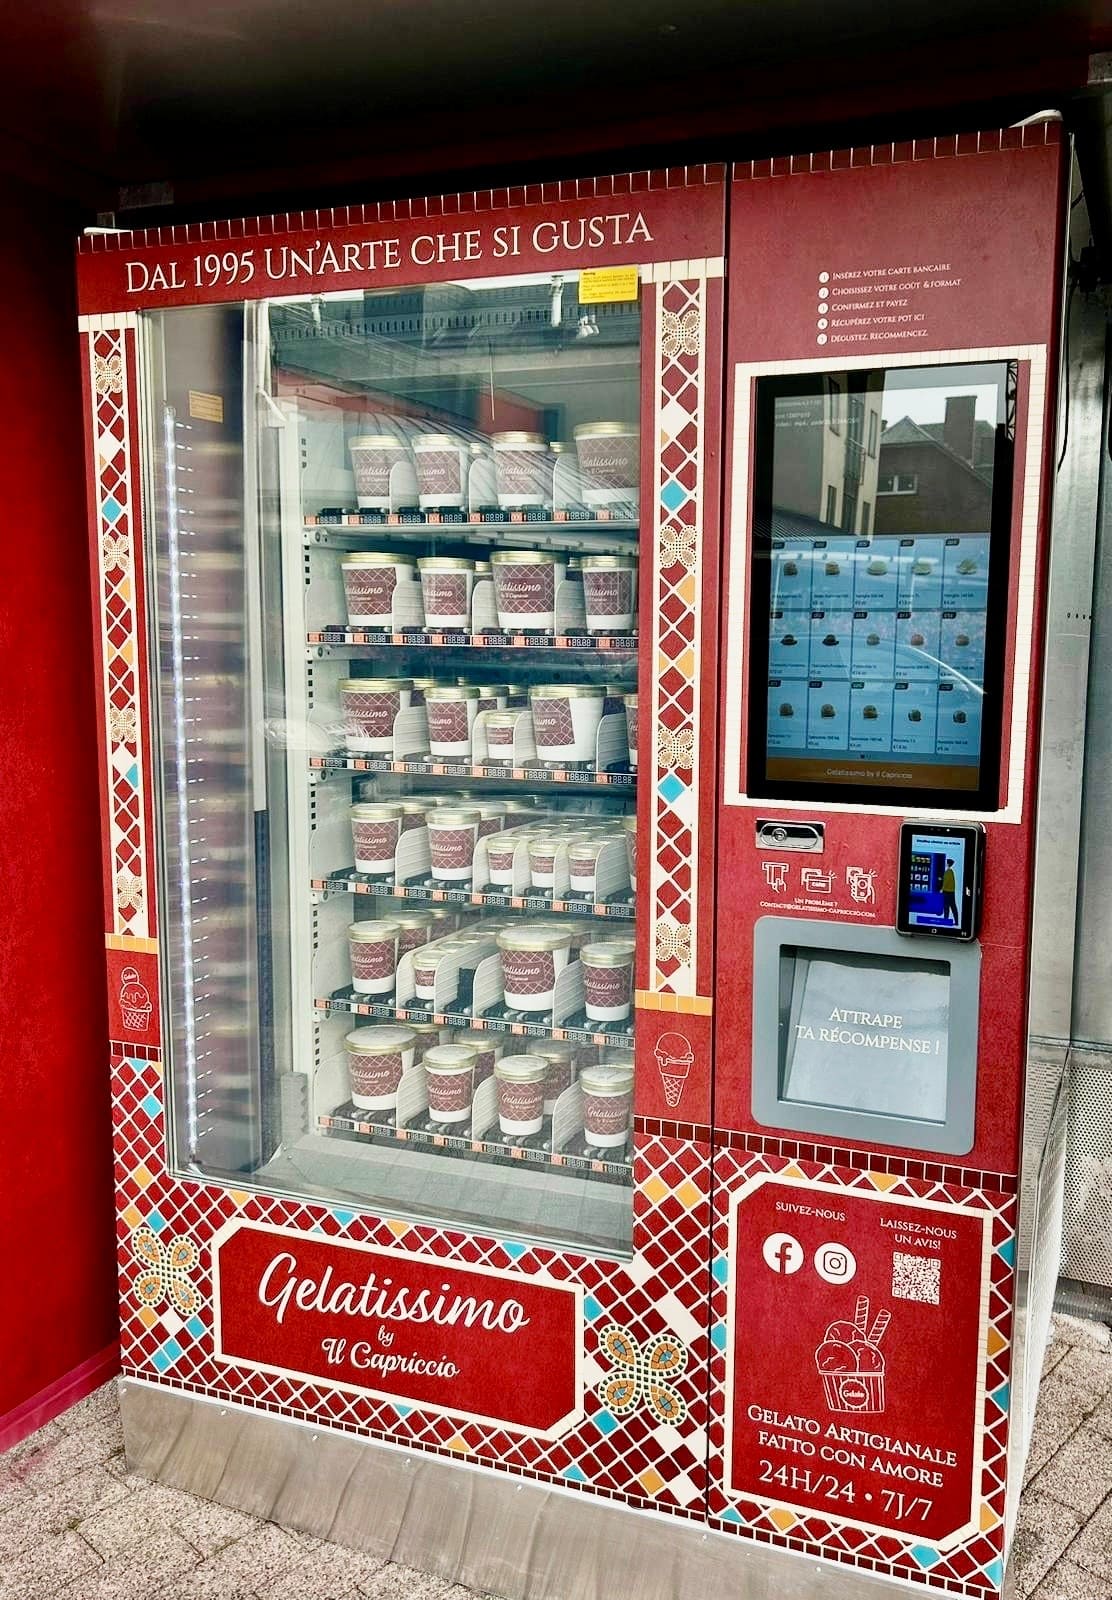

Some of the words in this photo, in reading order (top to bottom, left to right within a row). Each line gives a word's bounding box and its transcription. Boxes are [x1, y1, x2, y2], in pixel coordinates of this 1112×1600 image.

[125, 262, 186, 293] DAL
[194, 250, 255, 287] 1995
[265, 239, 402, 280] UN'ARTE
[410, 230, 483, 266] CHE
[493, 226, 521, 257] SI
[532, 212, 654, 253] GUSTA
[864, 269, 886, 277] VOTRE
[888, 266, 911, 275] CARTE
[832, 286, 872, 296] CHOISISSEZ
[874, 284, 897, 293] VOTRE
[930, 279, 961, 288] FORMAT
[831, 302, 874, 311] CONFIRMEZ
[876, 301, 884, 309] ET
[886, 299, 908, 308] PAYEZ
[873, 316, 896, 325] VOTRE
[898, 314, 912, 322] POT
[914, 313, 925, 321] ICI
[828, 1007, 903, 1029] ATTRAPE
[794, 1025, 815, 1041] TA
[819, 1027, 931, 1055] RÉCOMPENSE
[775, 1201, 846, 1222] SUIVEZ-NOUS
[880, 1217, 957, 1240] LAISSEZ-NOUS
[894, 1234, 912, 1246] UN
[913, 1236, 942, 1250] AVIS!
[258, 1252, 531, 1334] Gelatissimo
[377, 1324, 394, 1347] by
[350, 1341, 461, 1379] Capriccio
[747, 1404, 821, 1435] GELATO
[824, 1422, 957, 1468] ARTIGIANALE
[758, 1431, 815, 1457] FATTO
[820, 1446, 866, 1470] CON
[869, 1456, 944, 1488] AMORE
[759, 1459, 857, 1504] 24H/24
[880, 1489, 934, 1521] 7J/7
